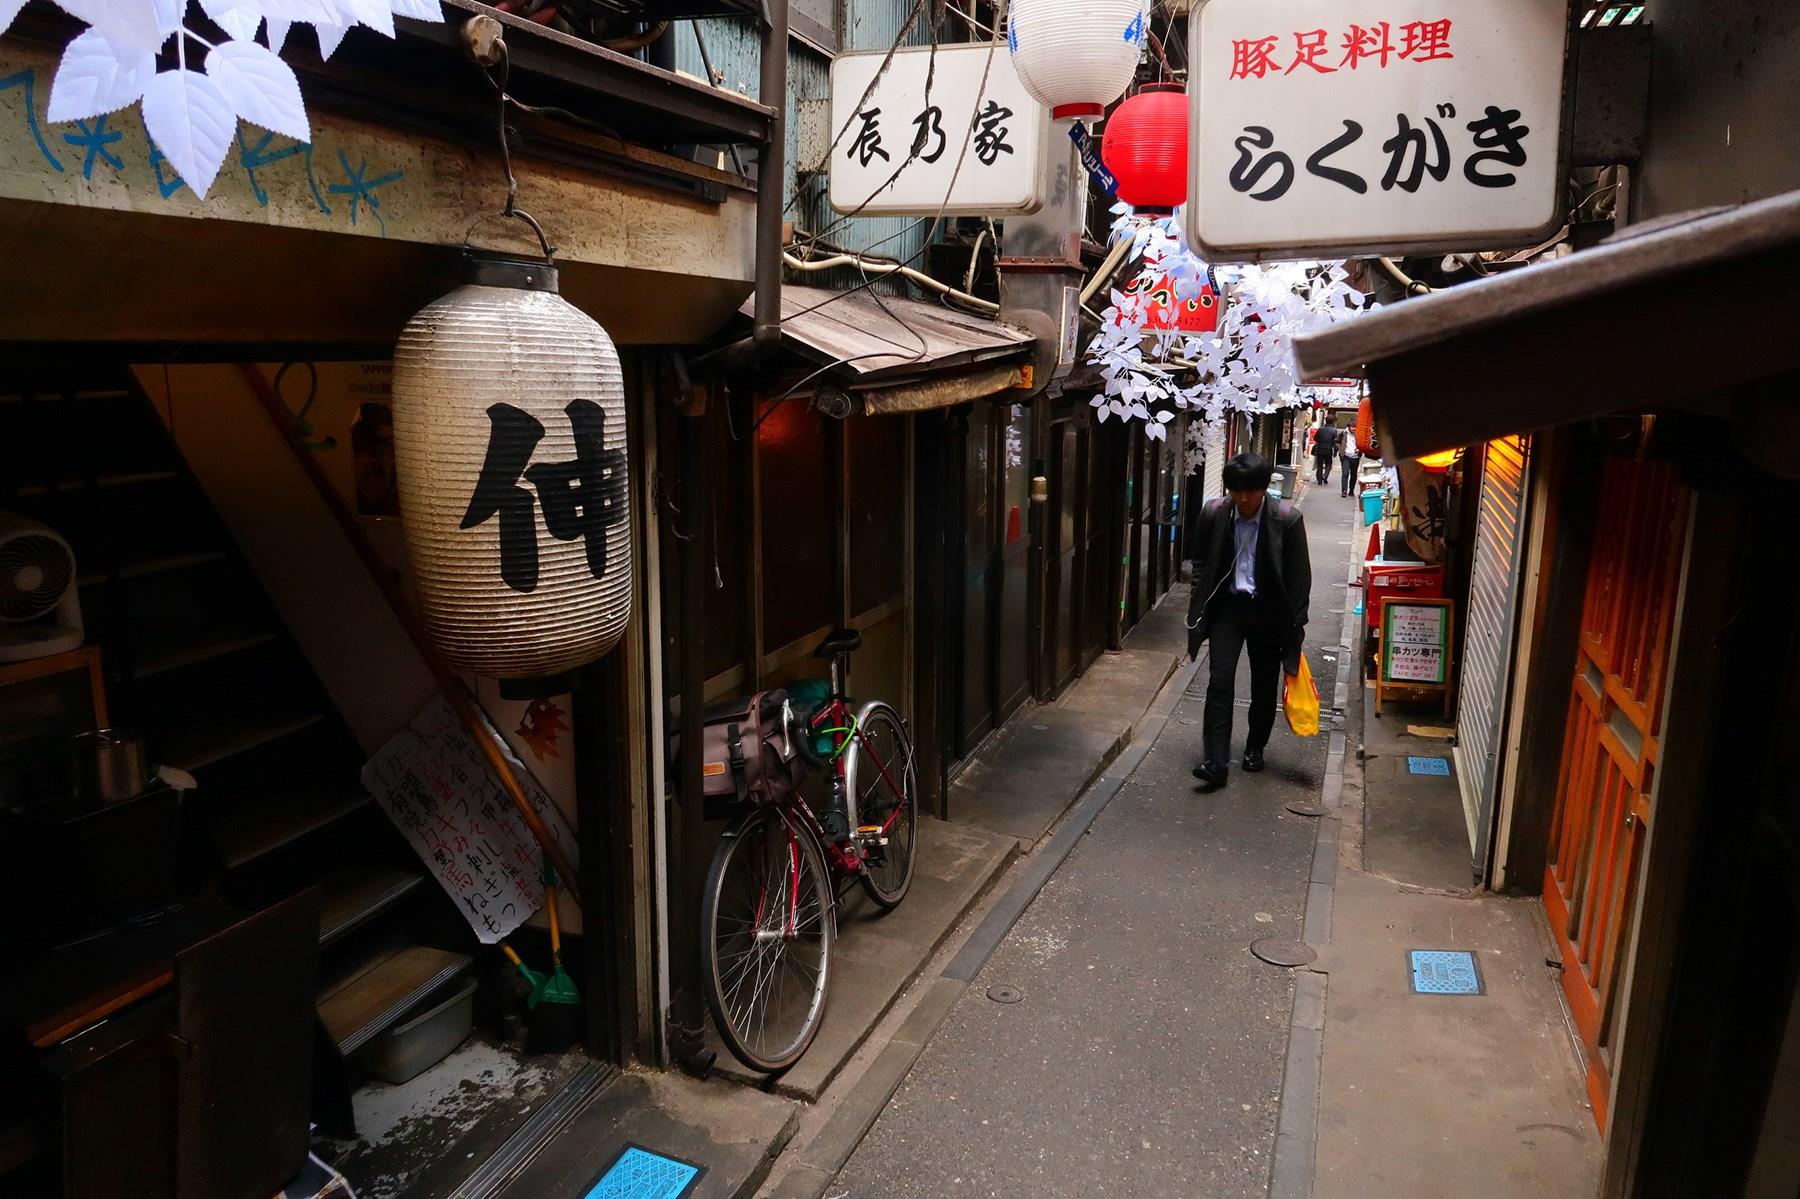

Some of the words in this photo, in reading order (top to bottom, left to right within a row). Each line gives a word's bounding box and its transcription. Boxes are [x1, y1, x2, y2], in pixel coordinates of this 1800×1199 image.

[1229, 18, 1454, 80] 豚足料理
[848, 100, 1014, 167] 辰乃家
[1229, 103, 1531, 201] らくがき
[460, 398, 628, 593] 伸
[1392, 646, 1441, 658] 串カツ専門
